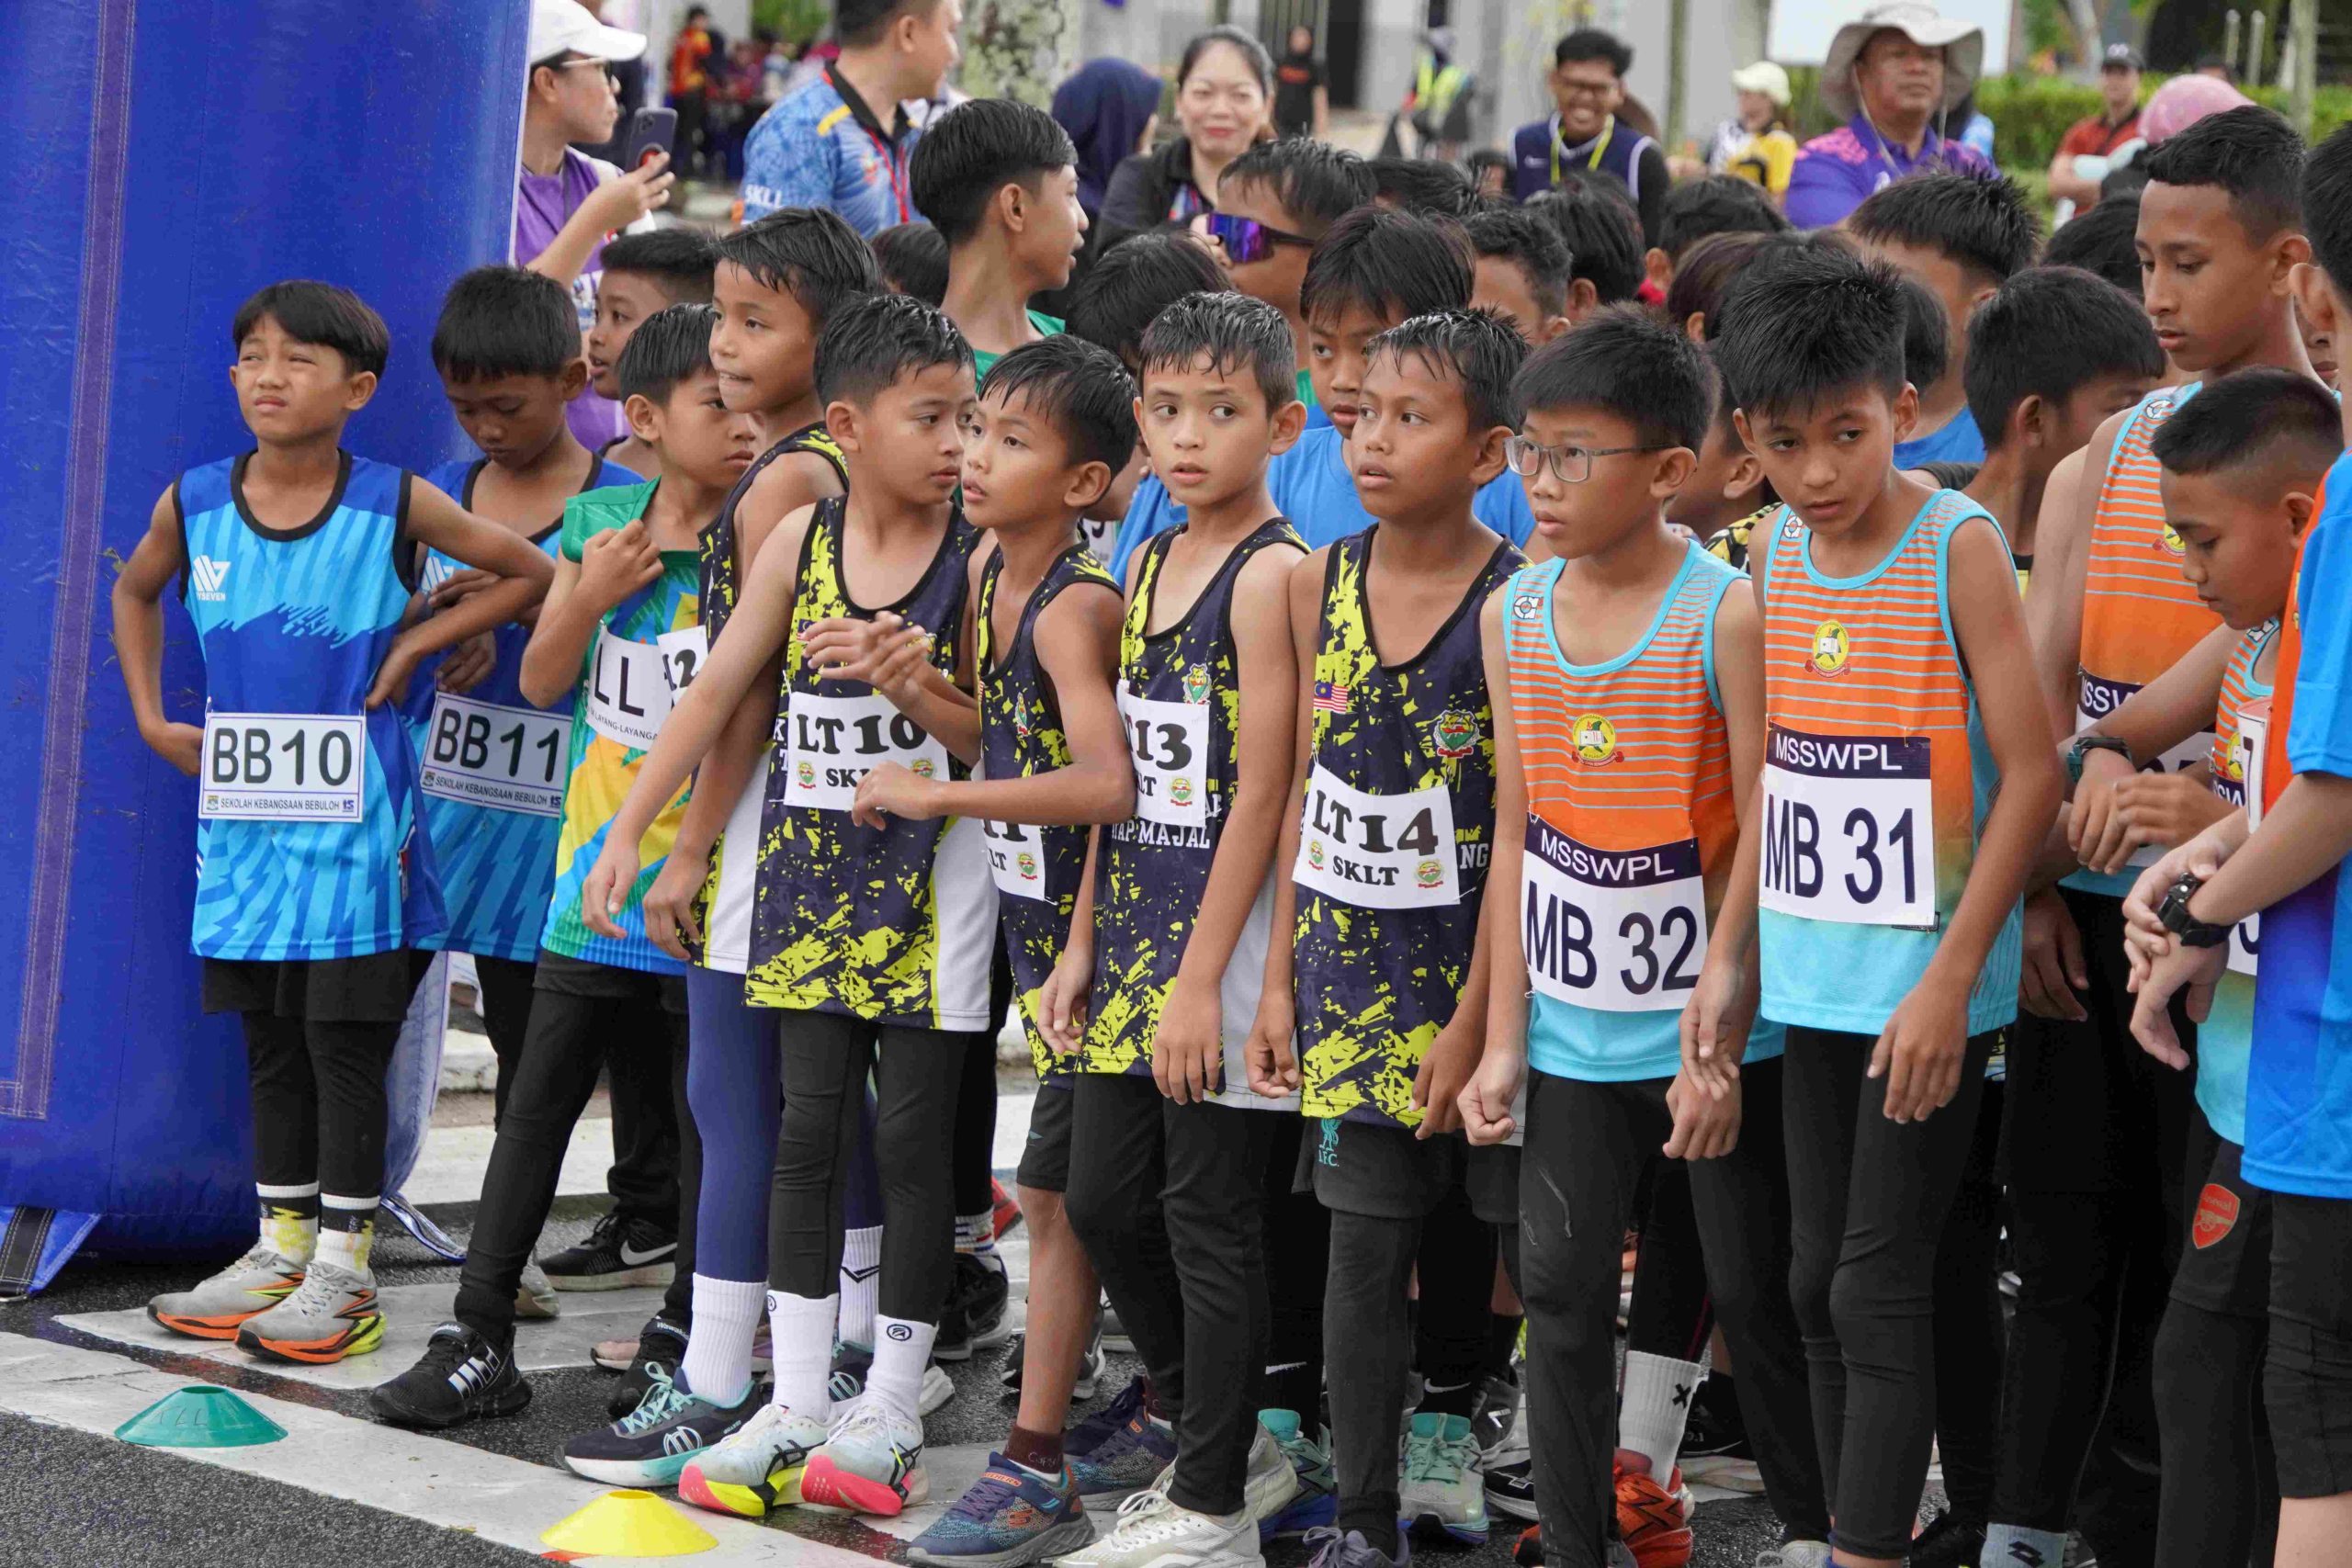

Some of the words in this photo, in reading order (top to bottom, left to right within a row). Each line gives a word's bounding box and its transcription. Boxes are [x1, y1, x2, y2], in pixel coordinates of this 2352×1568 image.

[212, 728, 352, 786] BB10
[1776, 733, 1902, 770] MSSWPL
[220, 798, 253, 808] SEKOLAH
[254, 798, 303, 809] KEBANGSAAN
[305, 800, 339, 810] BEBULOH
[435, 775, 464, 791] SEKOLAH
[465, 781, 513, 800] KEBANGSAAN
[514, 788, 547, 806] BEBULOH
[1137, 820, 1210, 849] MAJAL
[1765, 794, 1823, 897] MB
[1843, 807, 1916, 904] 31
[1333, 855, 1399, 886] SKLT
[1541, 829, 1675, 881] MSSWPL
[1527, 880, 1597, 989] MB
[1619, 906, 1700, 995] 32
